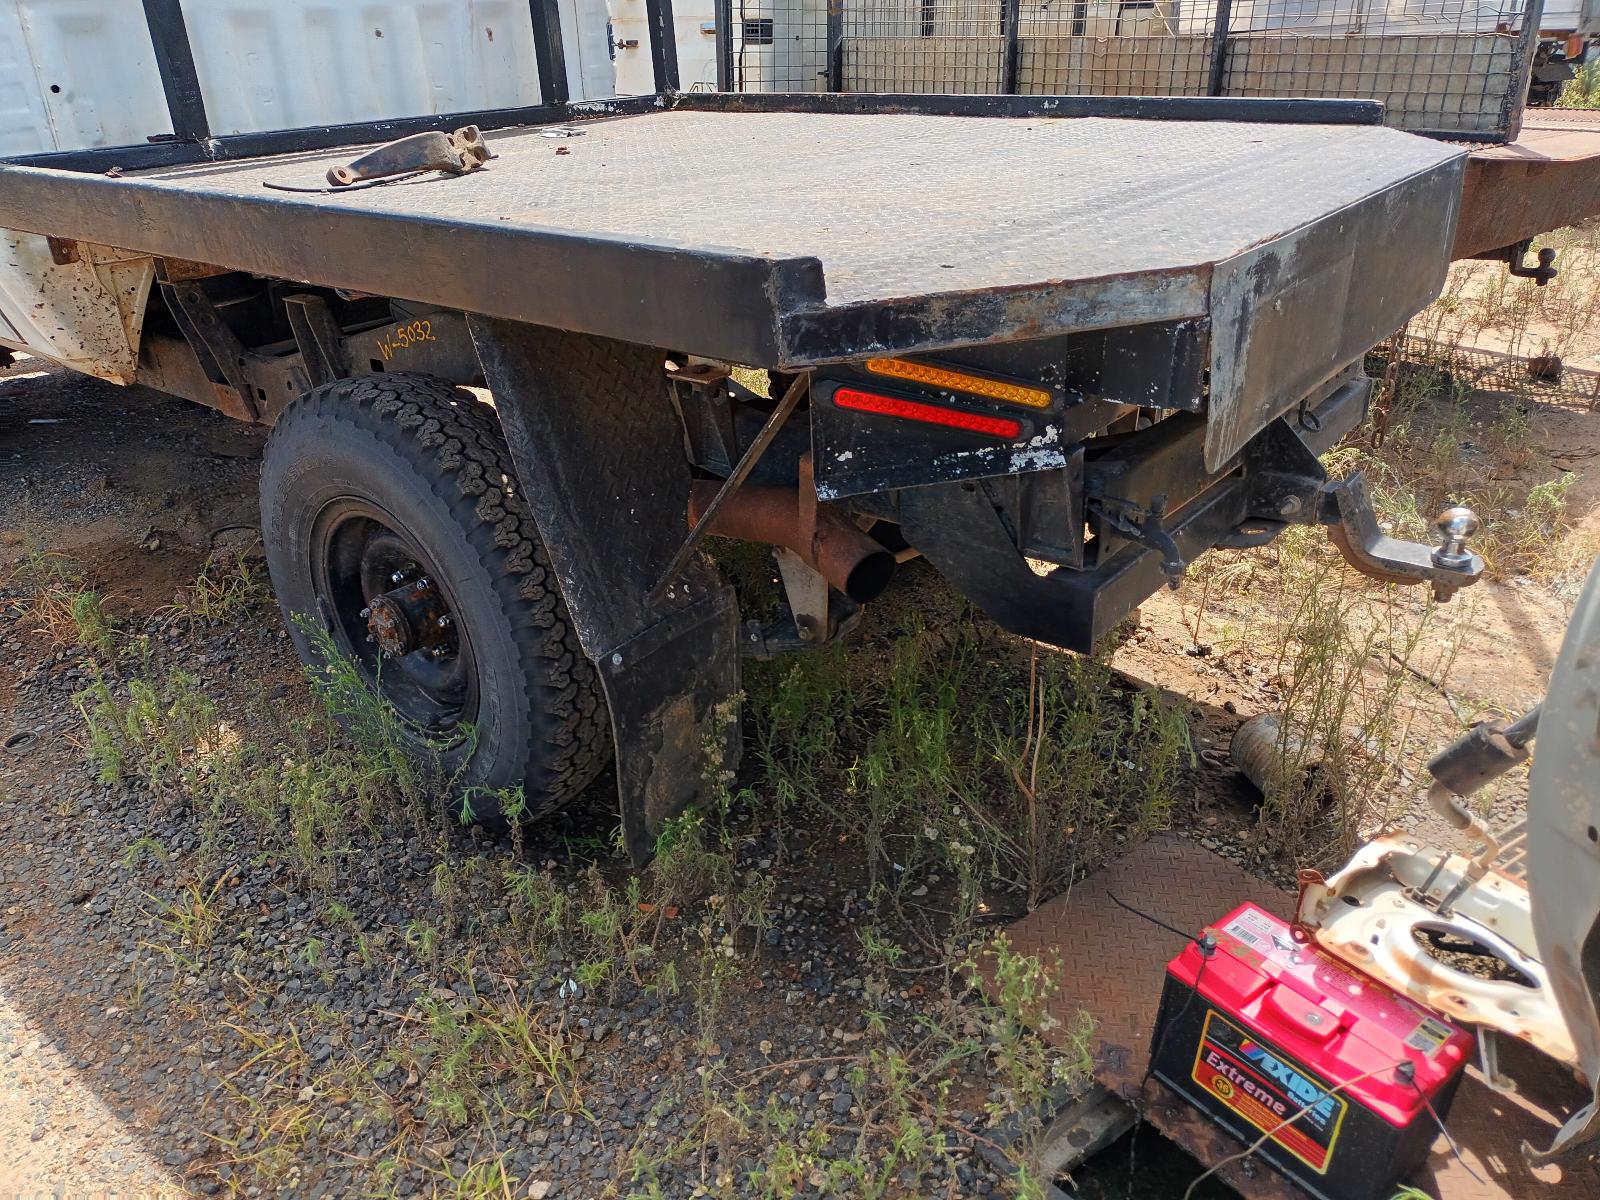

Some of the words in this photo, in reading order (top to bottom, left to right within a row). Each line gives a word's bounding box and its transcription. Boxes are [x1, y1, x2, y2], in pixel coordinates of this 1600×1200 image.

[377, 320, 436, 360] W-5032
[1206, 1051, 1286, 1116] Extreme
[1260, 1052, 1336, 1118] EXIDE
